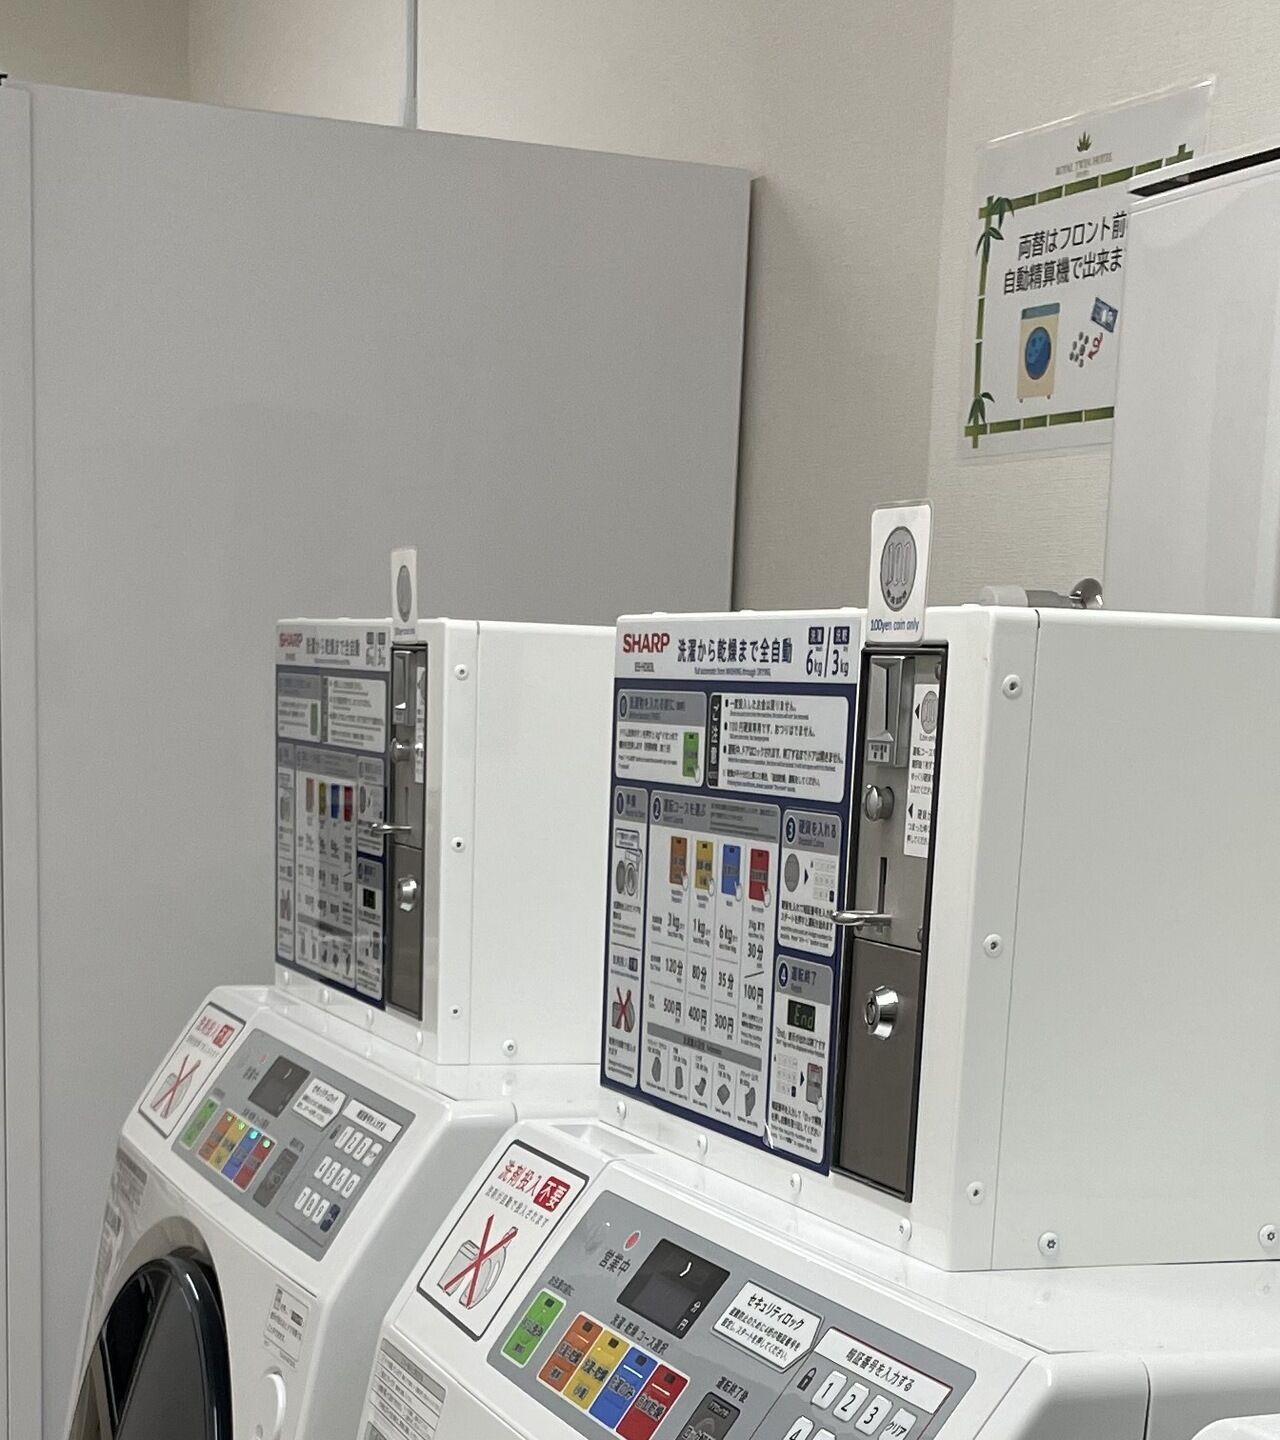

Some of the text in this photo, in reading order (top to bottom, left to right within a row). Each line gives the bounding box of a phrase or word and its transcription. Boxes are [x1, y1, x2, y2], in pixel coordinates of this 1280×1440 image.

[871, 619, 892, 632] 100yen
[907, 618, 919, 632] only
[623, 633, 670, 653] SHARP
[677, 637, 792, 663] 洗濯から乾燥まで全自動
[747, 1293, 805, 1332] セキュリティロック
[845, 1346, 916, 1393] 暗証番号を入力する
[822, 1381, 834, 1398] 1
[840, 1394, 856, 1413] 2
[863, 1406, 878, 1426] 3
[885, 1420, 908, 1439] クリア
